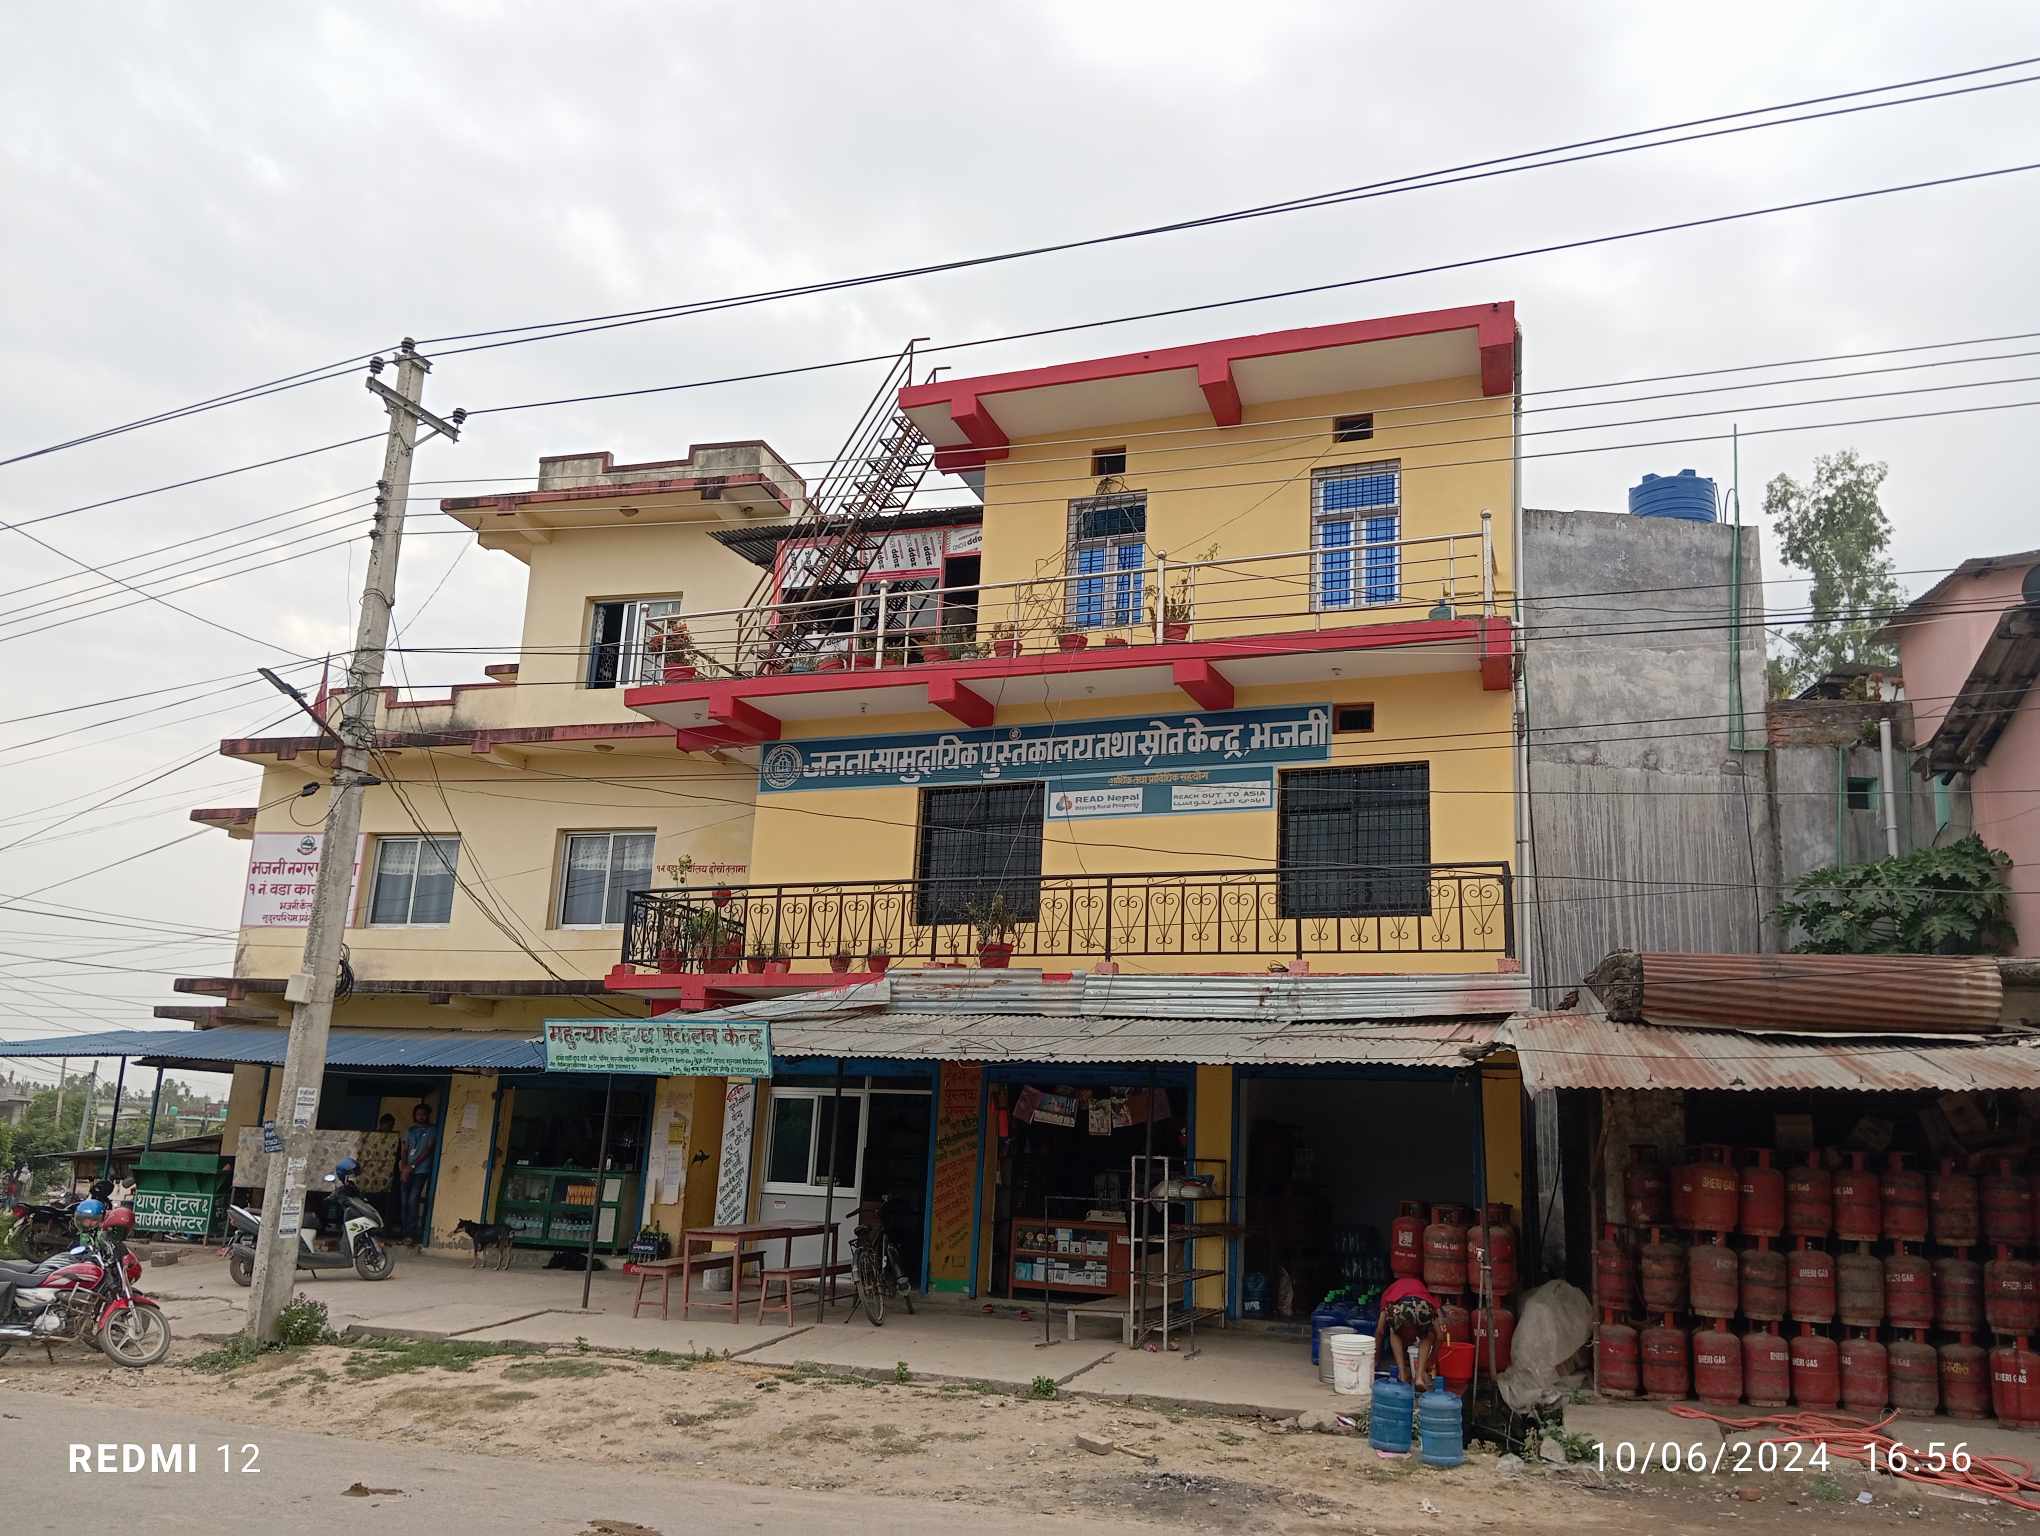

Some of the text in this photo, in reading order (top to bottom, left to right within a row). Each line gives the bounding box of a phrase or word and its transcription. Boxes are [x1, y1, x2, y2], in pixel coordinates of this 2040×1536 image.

[803, 749, 871, 778] जनता
[871, 735, 977, 783] सामुदायिक
[981, 736, 1093, 778] पुस्तकालय
[1095, 731, 1137, 759] तथा
[1249, 709, 1329, 746] भजनी
[1075, 792, 1140, 804] READ Nepal
[252, 857, 289, 875] भजनी
[270, 883, 292, 896] वडा
[136, 1193, 163, 1209] थापा
[164, 1194, 202, 1214] होटल
